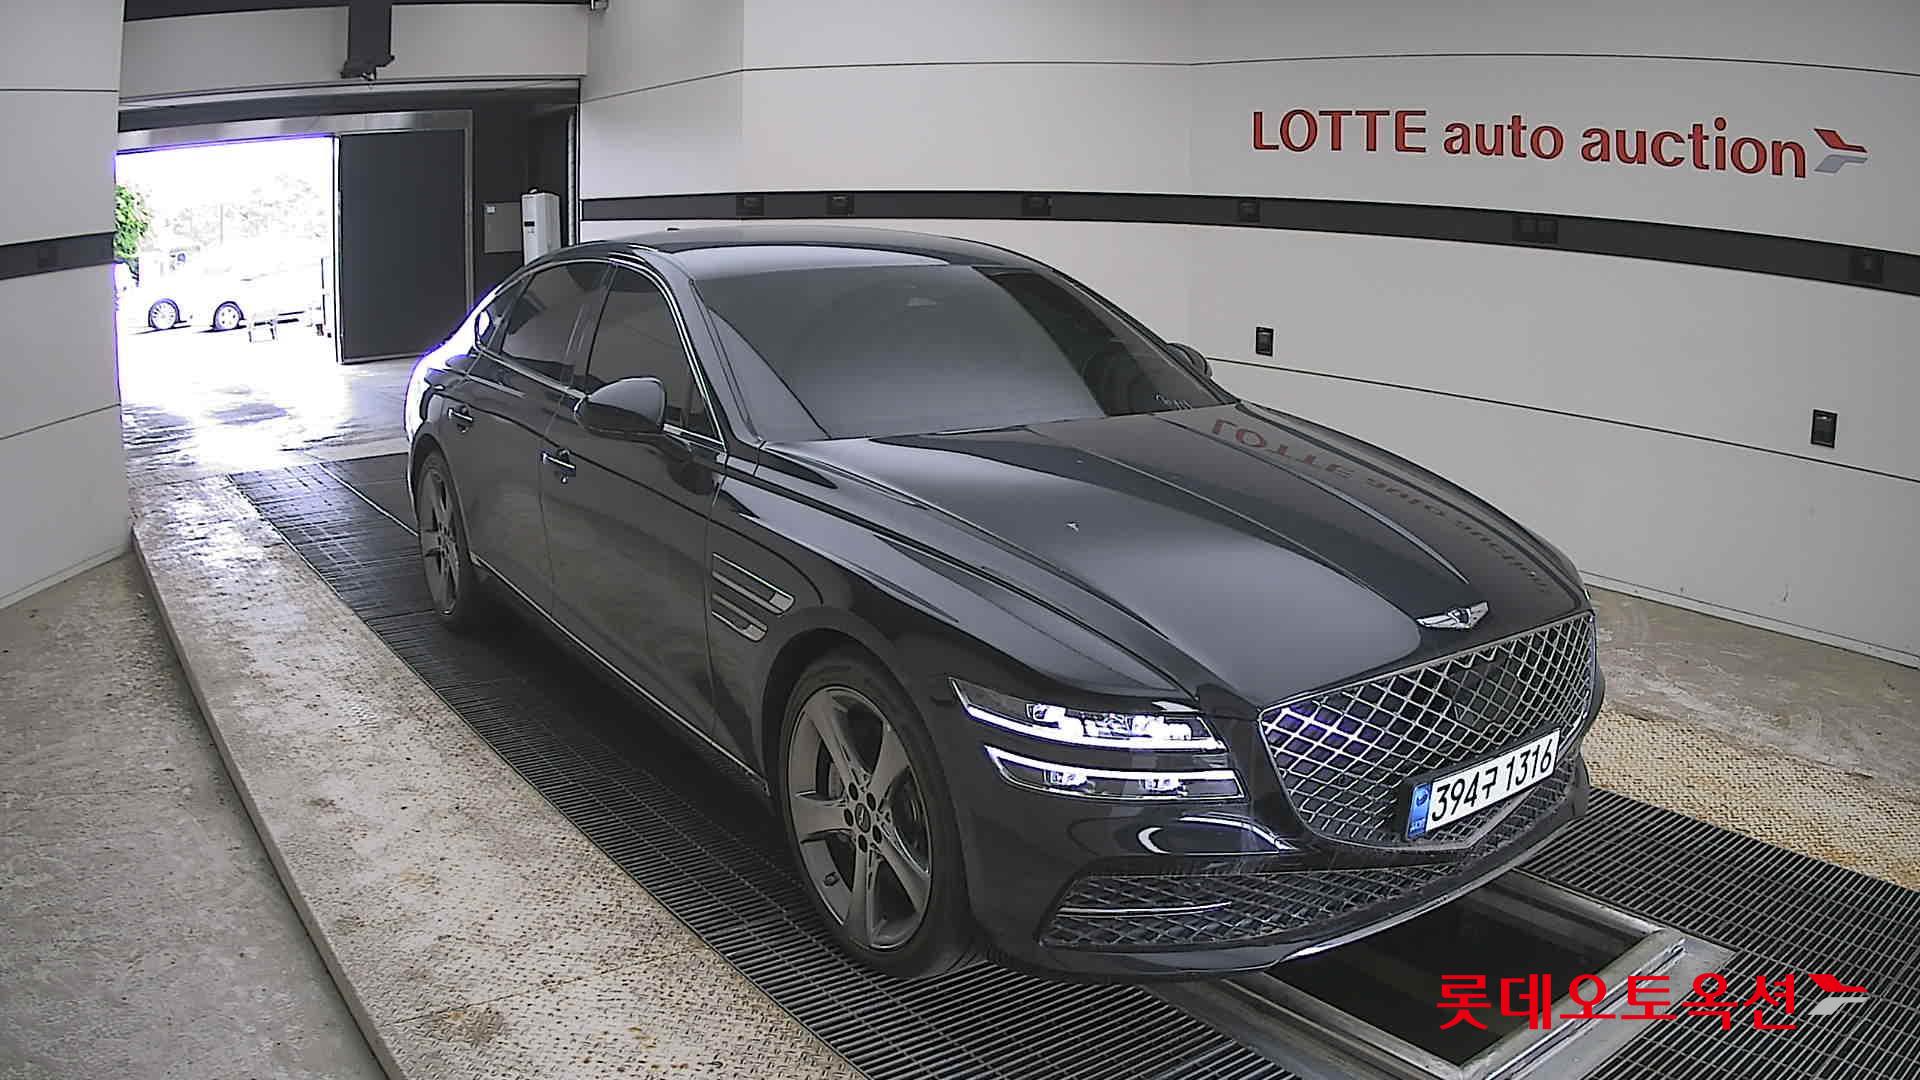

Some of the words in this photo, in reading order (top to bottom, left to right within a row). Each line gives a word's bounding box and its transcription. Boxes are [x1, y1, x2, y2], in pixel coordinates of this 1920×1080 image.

[1253, 110, 1427, 153] LOTTE
[1443, 115, 1565, 160] auto
[1581, 117, 1806, 178] auction
[1431, 766, 1498, 822] 394구
[1506, 739, 1553, 791] 1316
